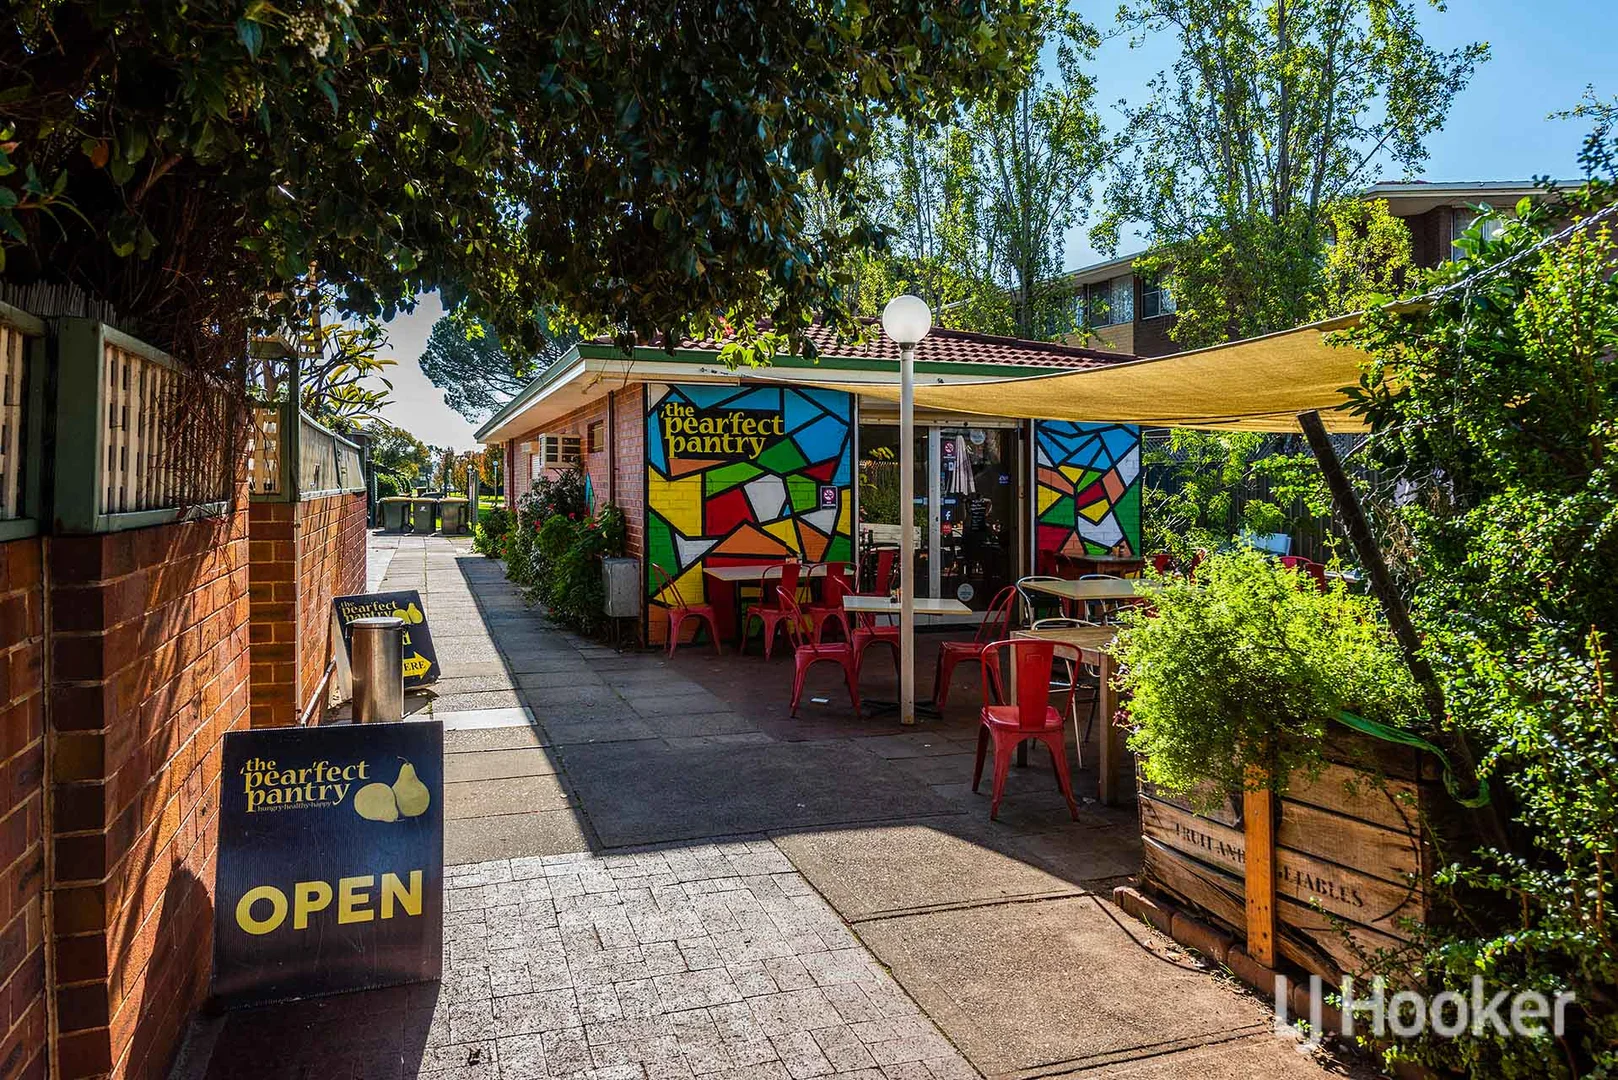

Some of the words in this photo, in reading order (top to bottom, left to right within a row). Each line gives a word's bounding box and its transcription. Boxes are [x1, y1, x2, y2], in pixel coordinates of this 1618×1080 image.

[665, 402, 695, 417] the
[668, 432, 766, 460] pantry
[404, 661, 426, 672] ERE
[246, 757, 277, 772] the
[245, 782, 352, 813] pantry
[235, 870, 423, 935] OPEN
